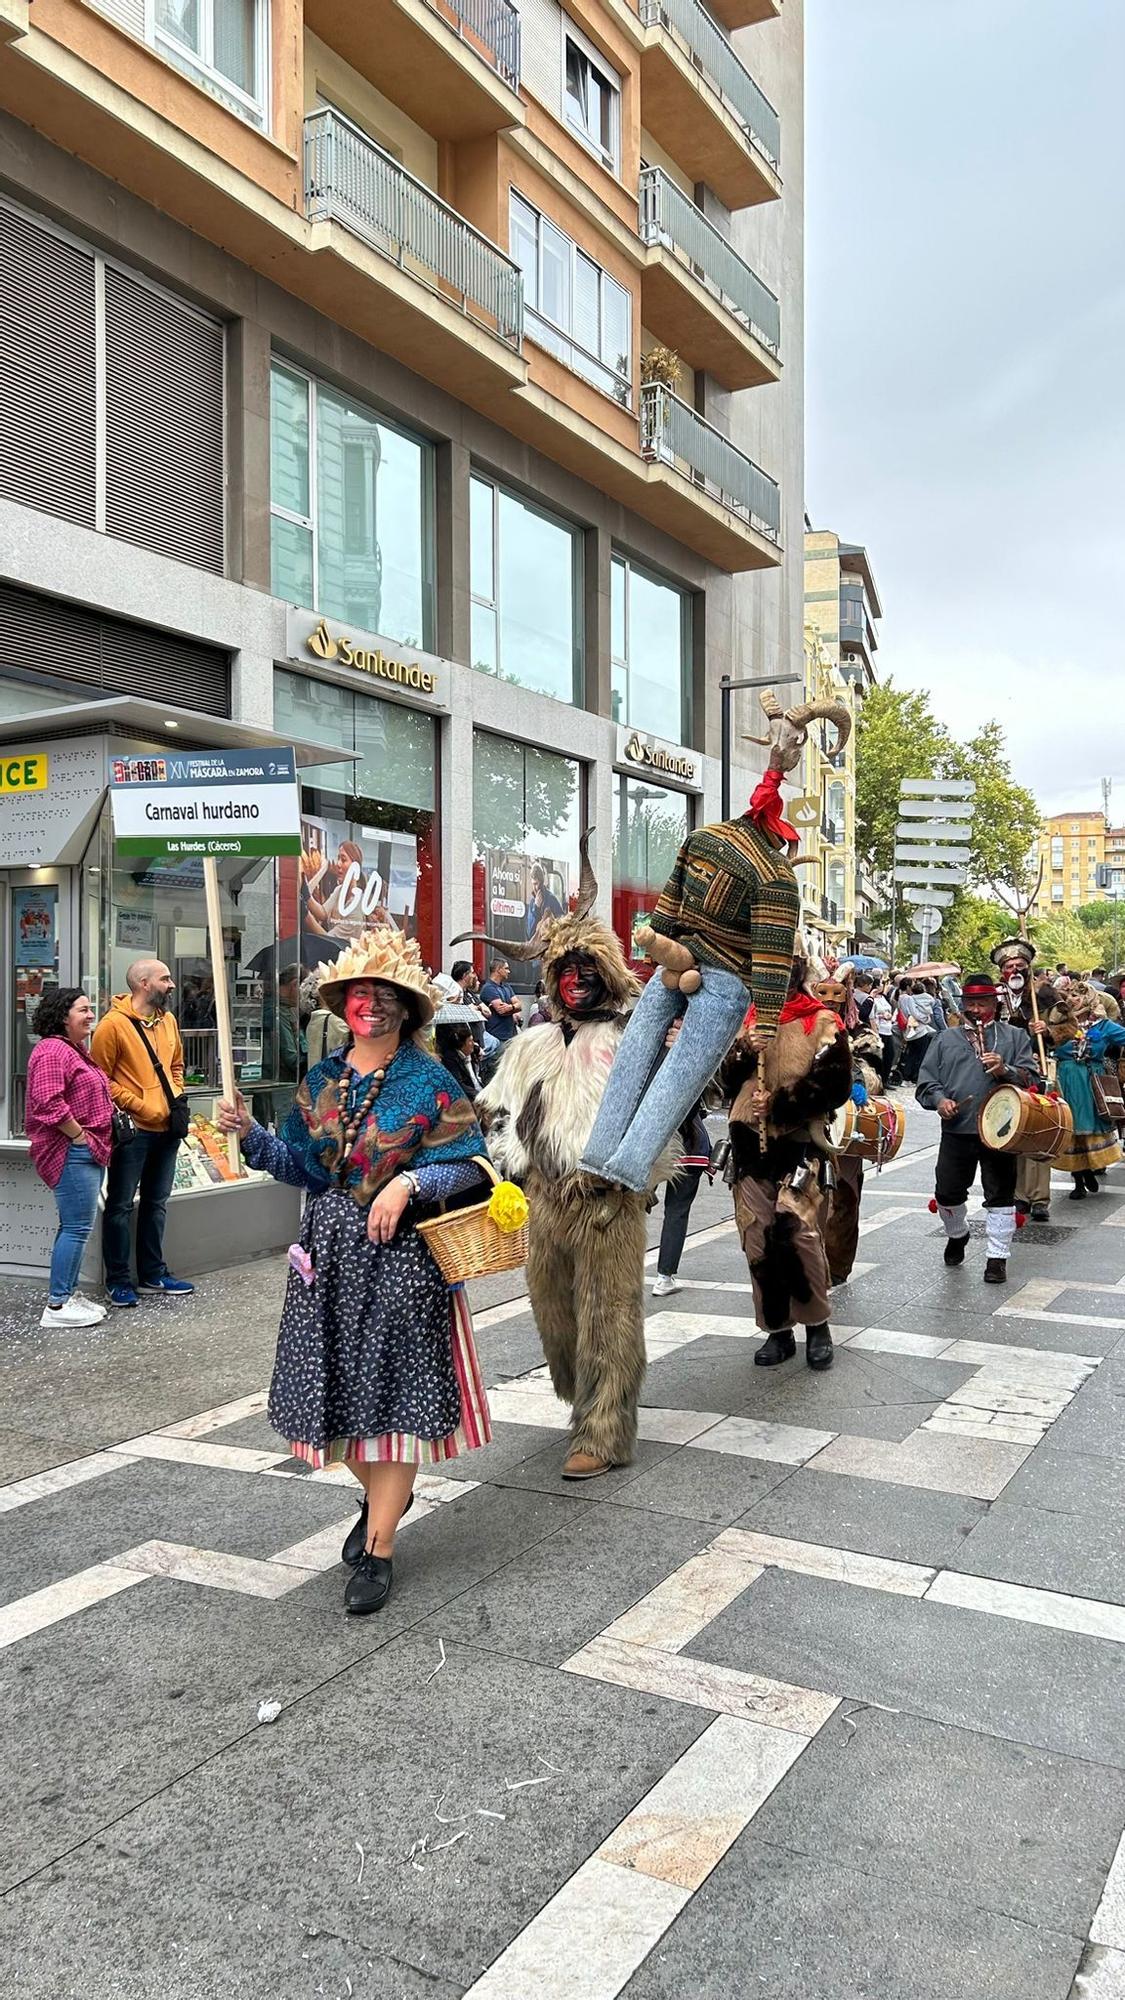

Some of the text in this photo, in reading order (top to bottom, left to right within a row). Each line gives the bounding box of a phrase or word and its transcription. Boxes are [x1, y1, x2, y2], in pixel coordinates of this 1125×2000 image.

[338, 637, 440, 694] Santander
[0, 760, 38, 787] CE
[169, 761, 190, 779] XIV
[228, 769, 236, 777] EN
[236, 767, 265, 777] ZAMORA
[145, 801, 259, 820] Carnaval hurdano
[167, 841, 242, 852] Las Hurdes (Cáceres)
[493, 867, 513, 880] Ahora
[338, 861, 383, 917] GO
[499, 883, 505, 896] la
[493, 900, 514, 913] última
